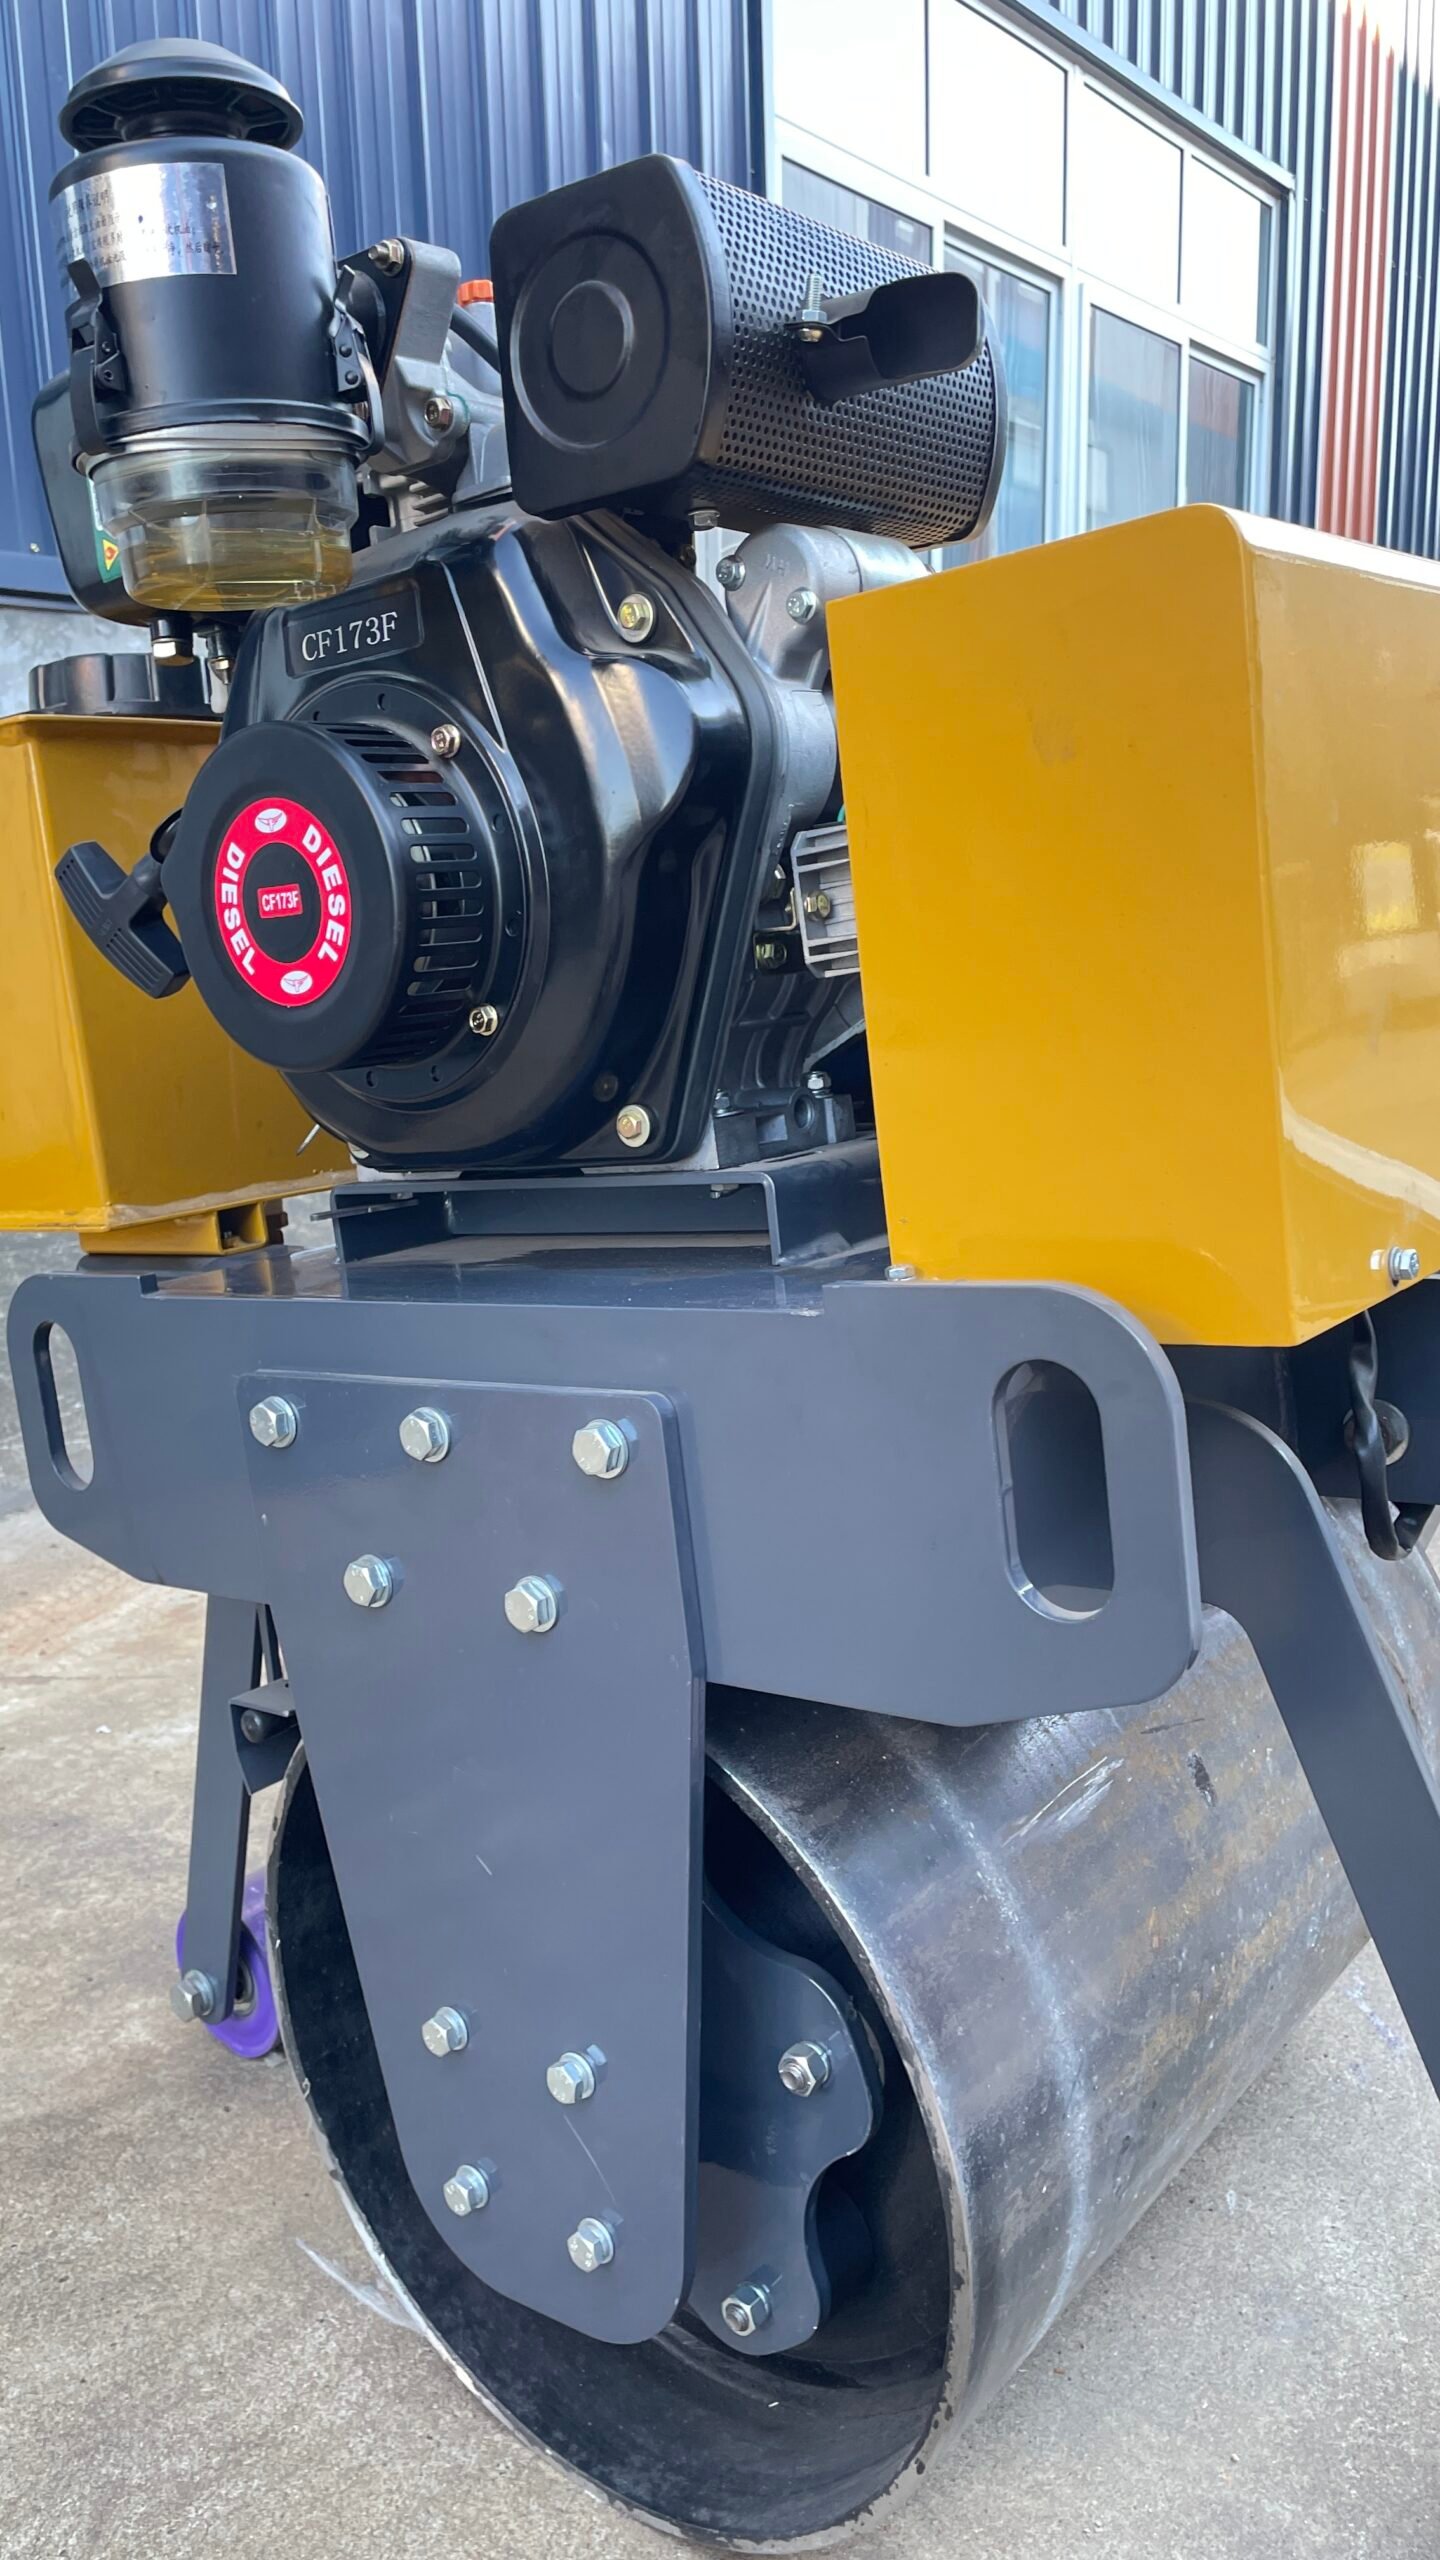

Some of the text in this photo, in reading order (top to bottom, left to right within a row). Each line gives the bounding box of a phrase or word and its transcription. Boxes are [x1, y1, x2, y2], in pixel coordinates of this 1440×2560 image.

[302, 611, 398, 661] CF173F
[221, 842, 255, 976] DIESEL
[261, 890, 299, 912] CF173F
[302, 824, 346, 962] DIESEL
